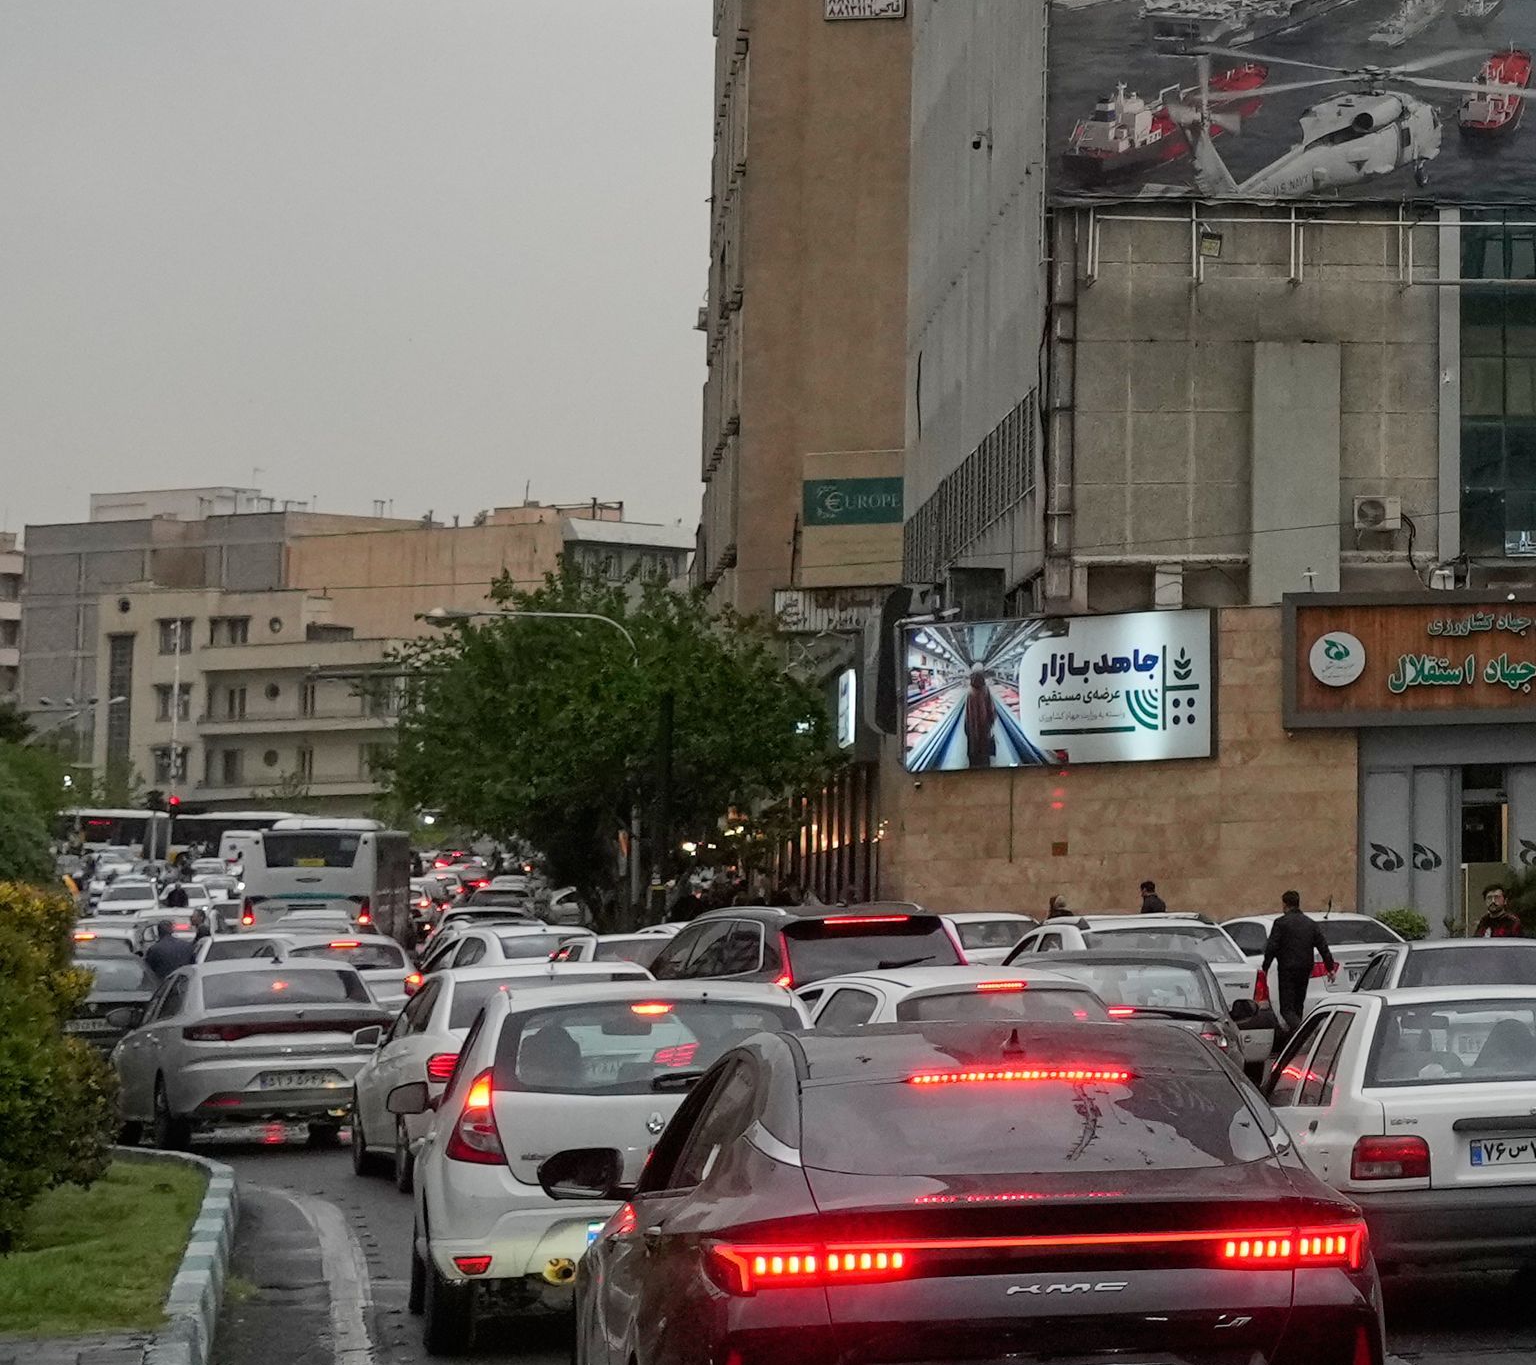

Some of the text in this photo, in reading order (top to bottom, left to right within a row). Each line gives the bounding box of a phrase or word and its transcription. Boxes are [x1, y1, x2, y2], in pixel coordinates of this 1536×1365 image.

[1427, 612, 1494, 635] کشاورزی
[1496, 613, 1531, 635] جهاد
[1038, 648, 1159, 686] جاهد بازار
[1388, 653, 1475, 693] استقلال
[1038, 691, 1081, 708] مستقیم
[1006, 1281, 1129, 1296] KMC
